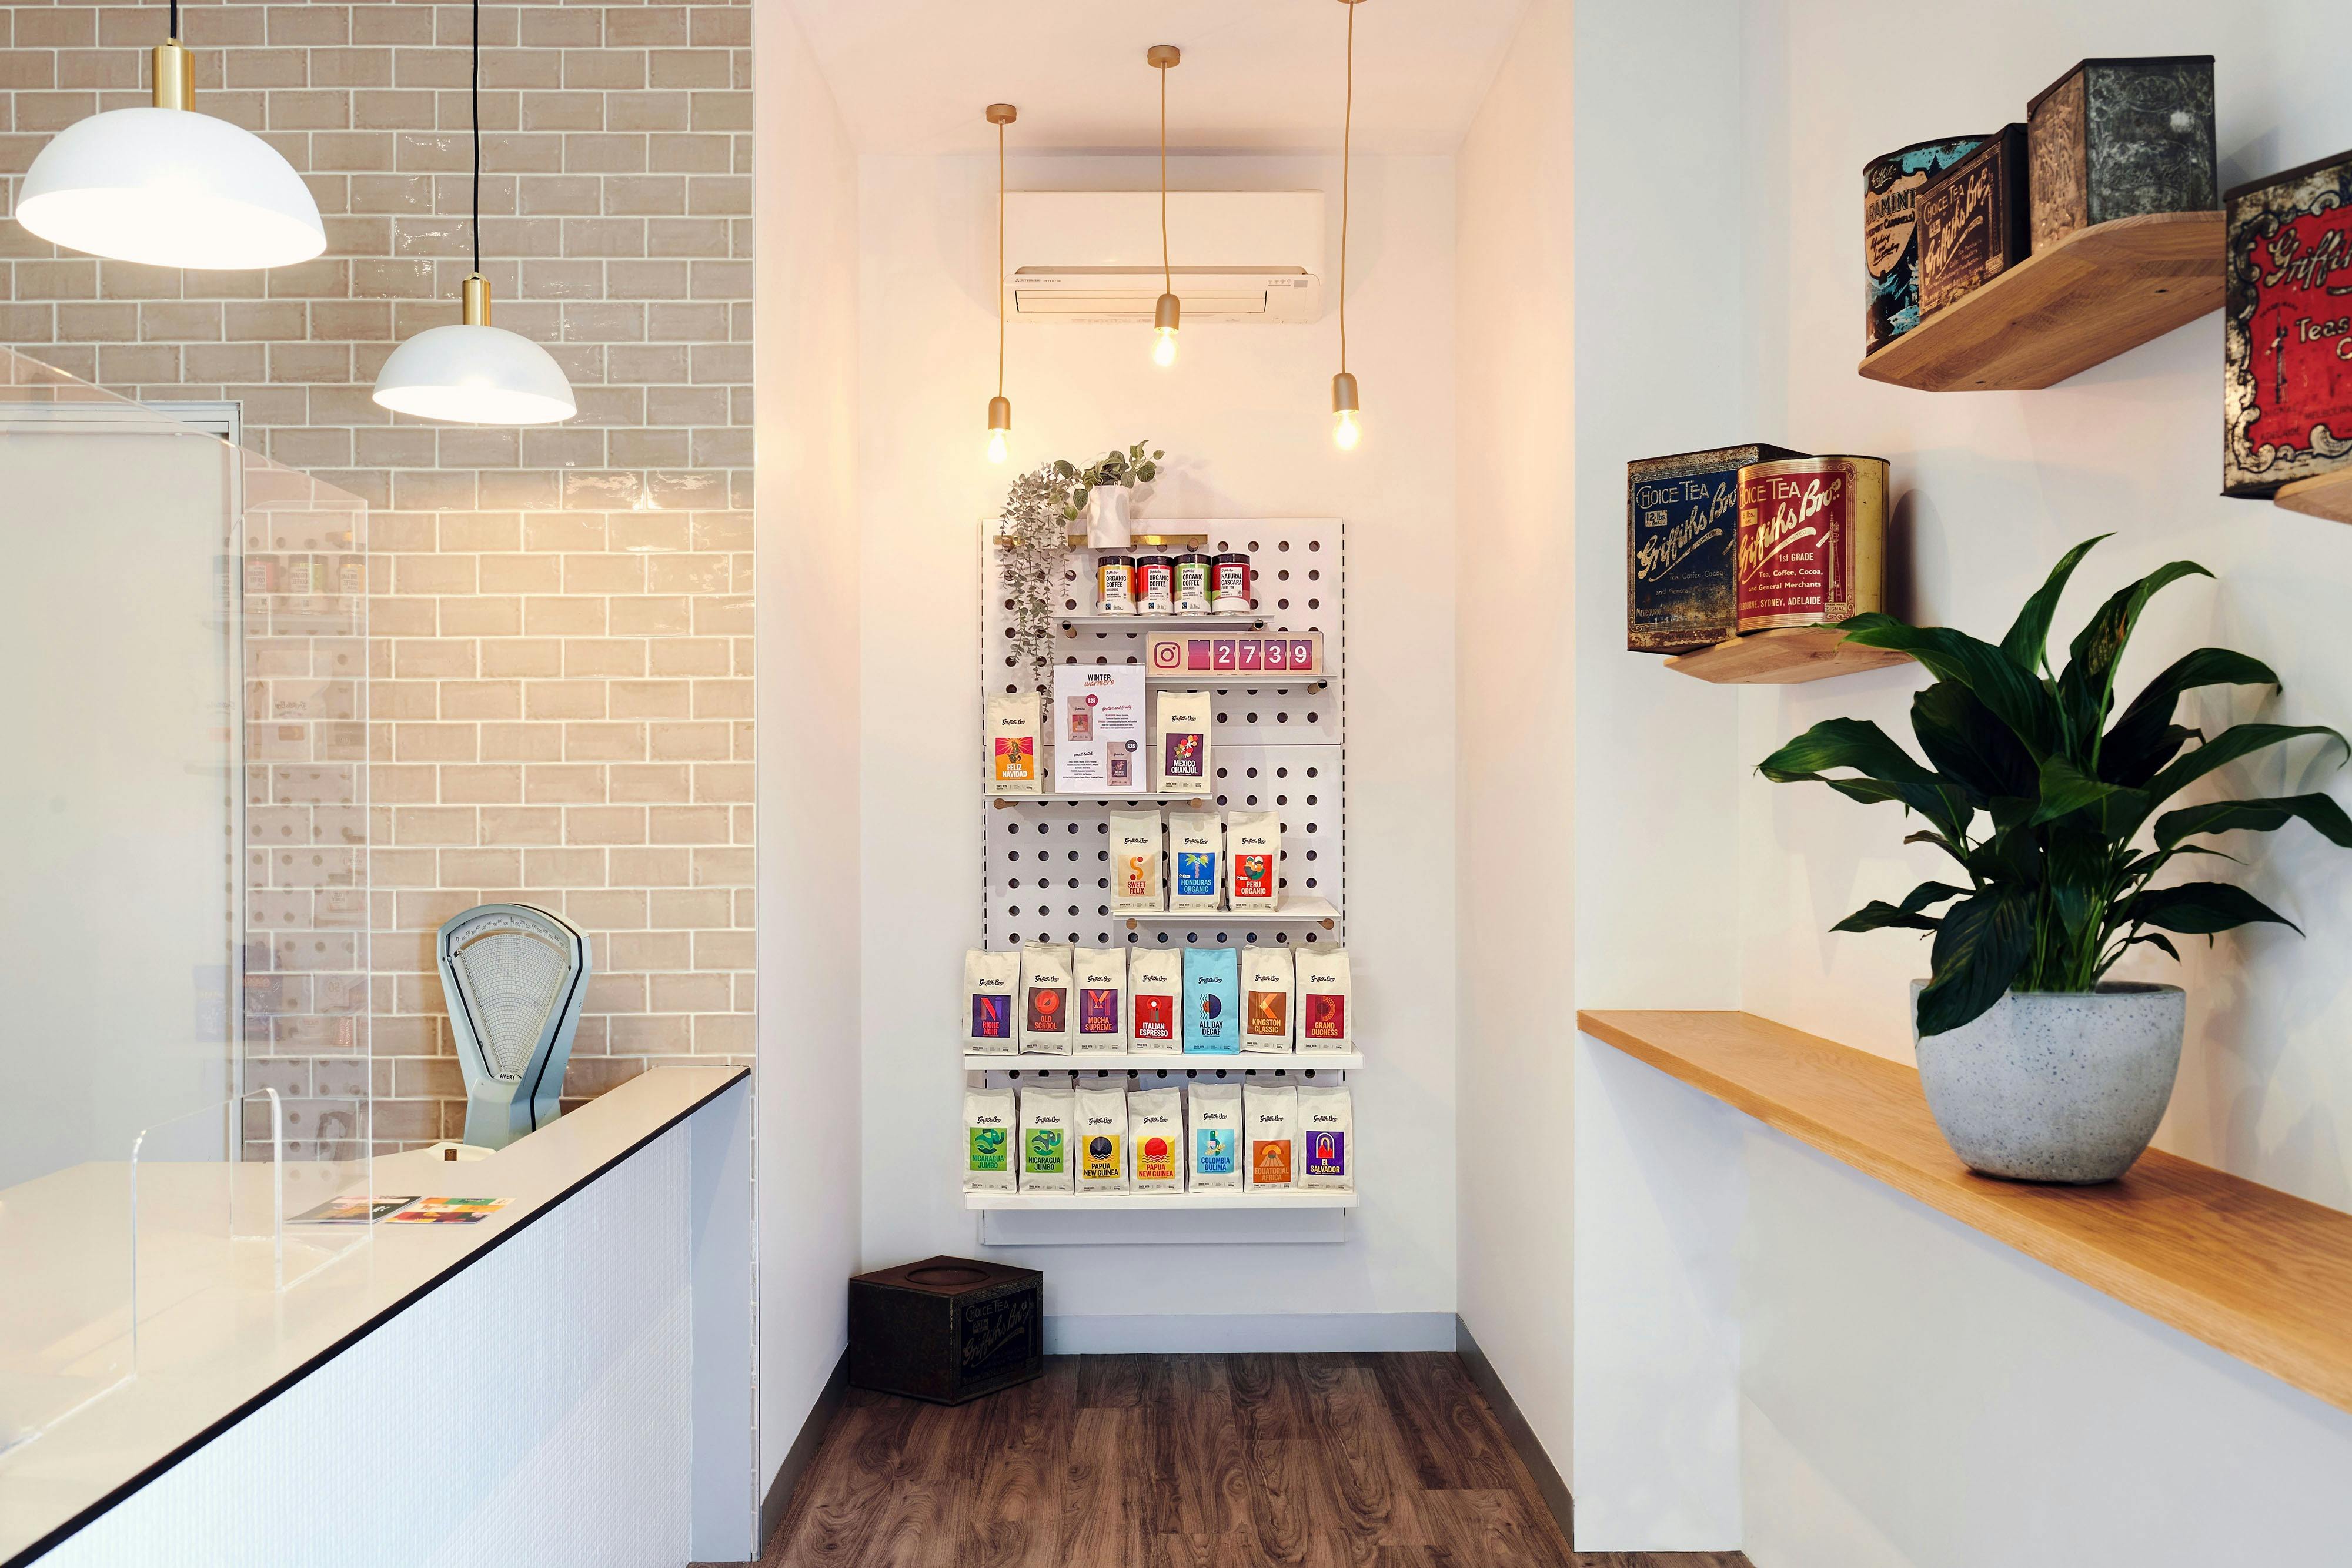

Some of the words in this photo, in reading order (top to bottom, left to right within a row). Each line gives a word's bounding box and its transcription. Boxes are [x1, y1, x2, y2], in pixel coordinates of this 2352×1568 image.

[1924, 195, 1948, 225] CHOICE
[1949, 185, 1964, 204] TEA
[1925, 198, 1966, 286] Griffiths
[2264, 229, 2352, 287] Griffi
[2296, 317, 2350, 343] Teas
[2337, 337, 2352, 359] C
[1636, 486, 1679, 509] CHOICE
[1679, 481, 1709, 501] TEA
[1766, 478, 1801, 500] TEA
[1646, 513, 1654, 521] 12
[1637, 505, 1707, 579] Griffiths
[1709, 482, 1736, 524] Bro
[1738, 502, 1797, 581] Griffiths
[1786, 530, 1807, 544] LIMITED
[1792, 553, 1813, 561] GRADE
[1739, 601, 1759, 610] ELBOURNE,
[1761, 598, 1785, 607] SYDNEY,
[966, 1305, 993, 1322] CHOICE
[992, 1299, 1009, 1312] TEA
[962, 1314, 1006, 1366] Griffiths
